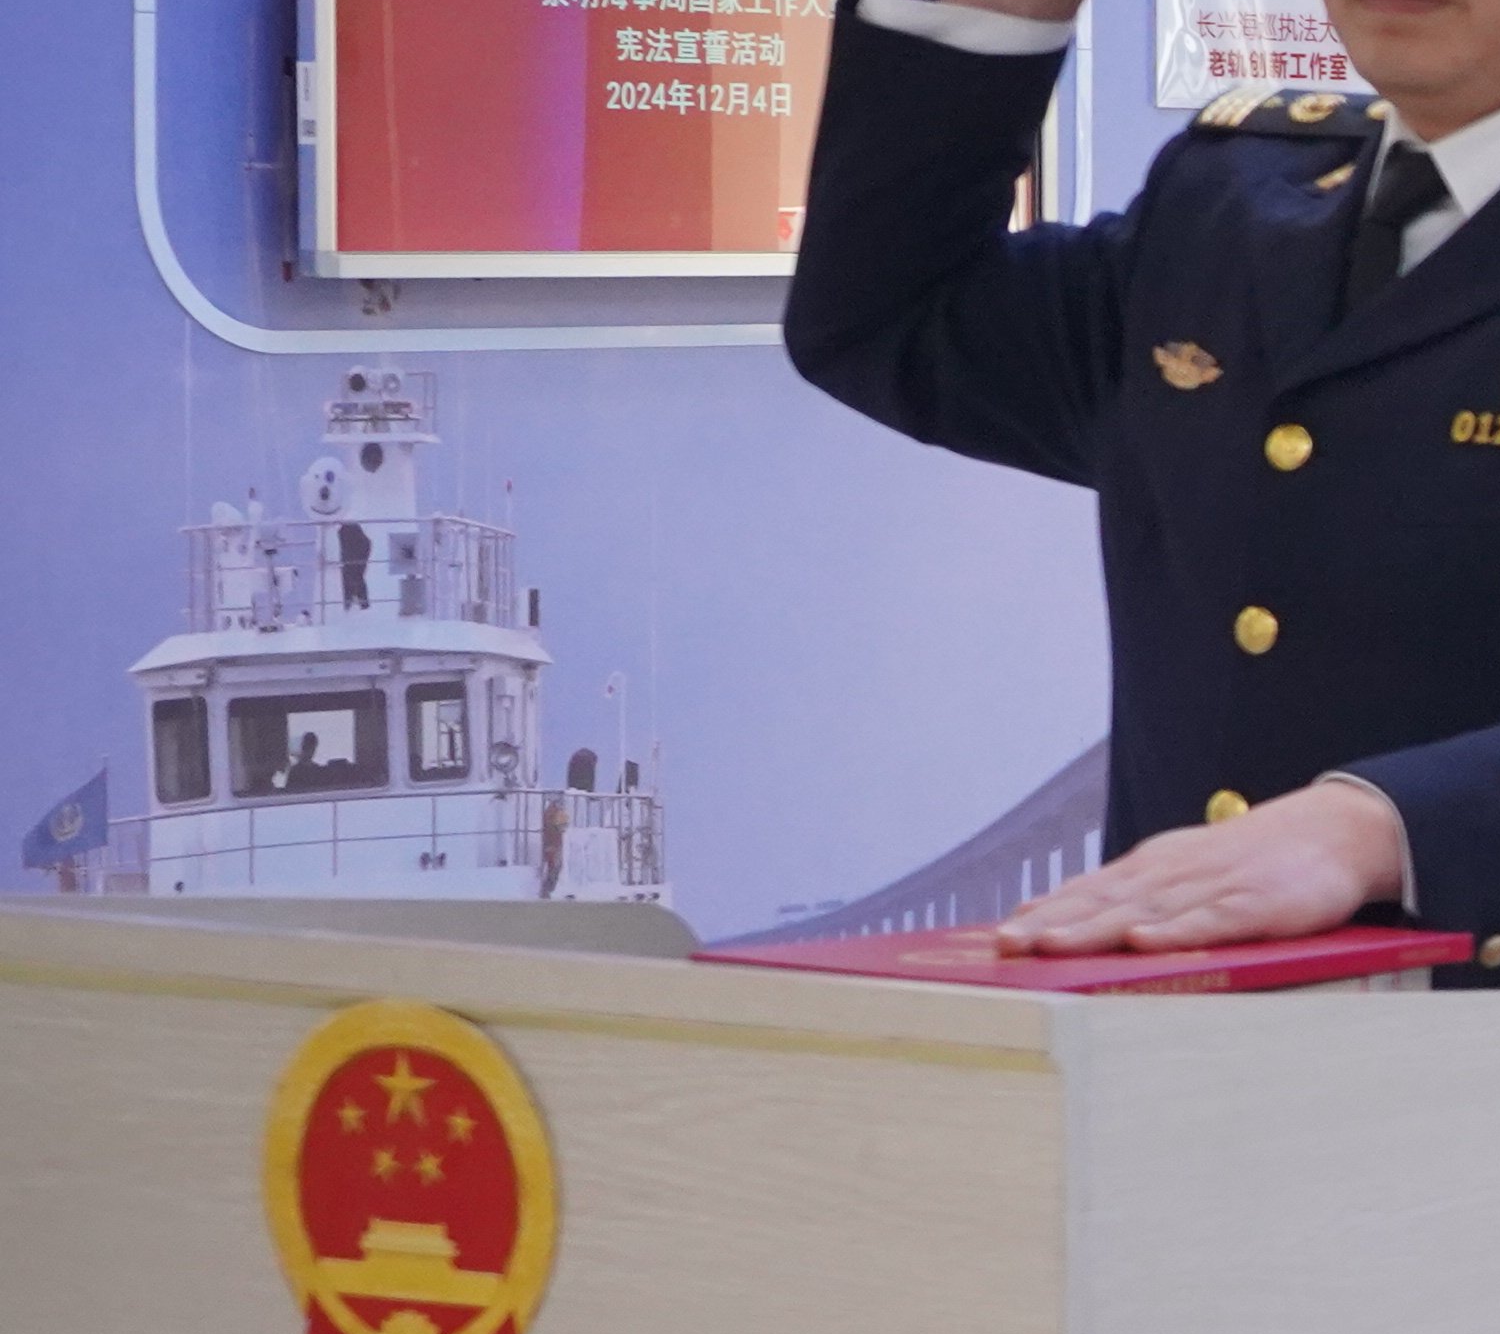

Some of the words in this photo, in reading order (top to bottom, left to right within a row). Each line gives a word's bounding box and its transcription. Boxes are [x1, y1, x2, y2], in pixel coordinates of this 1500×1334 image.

[616, 26, 786, 67] 宪法宣誓活动
[605, 79, 792, 117] 2024年12月4日
